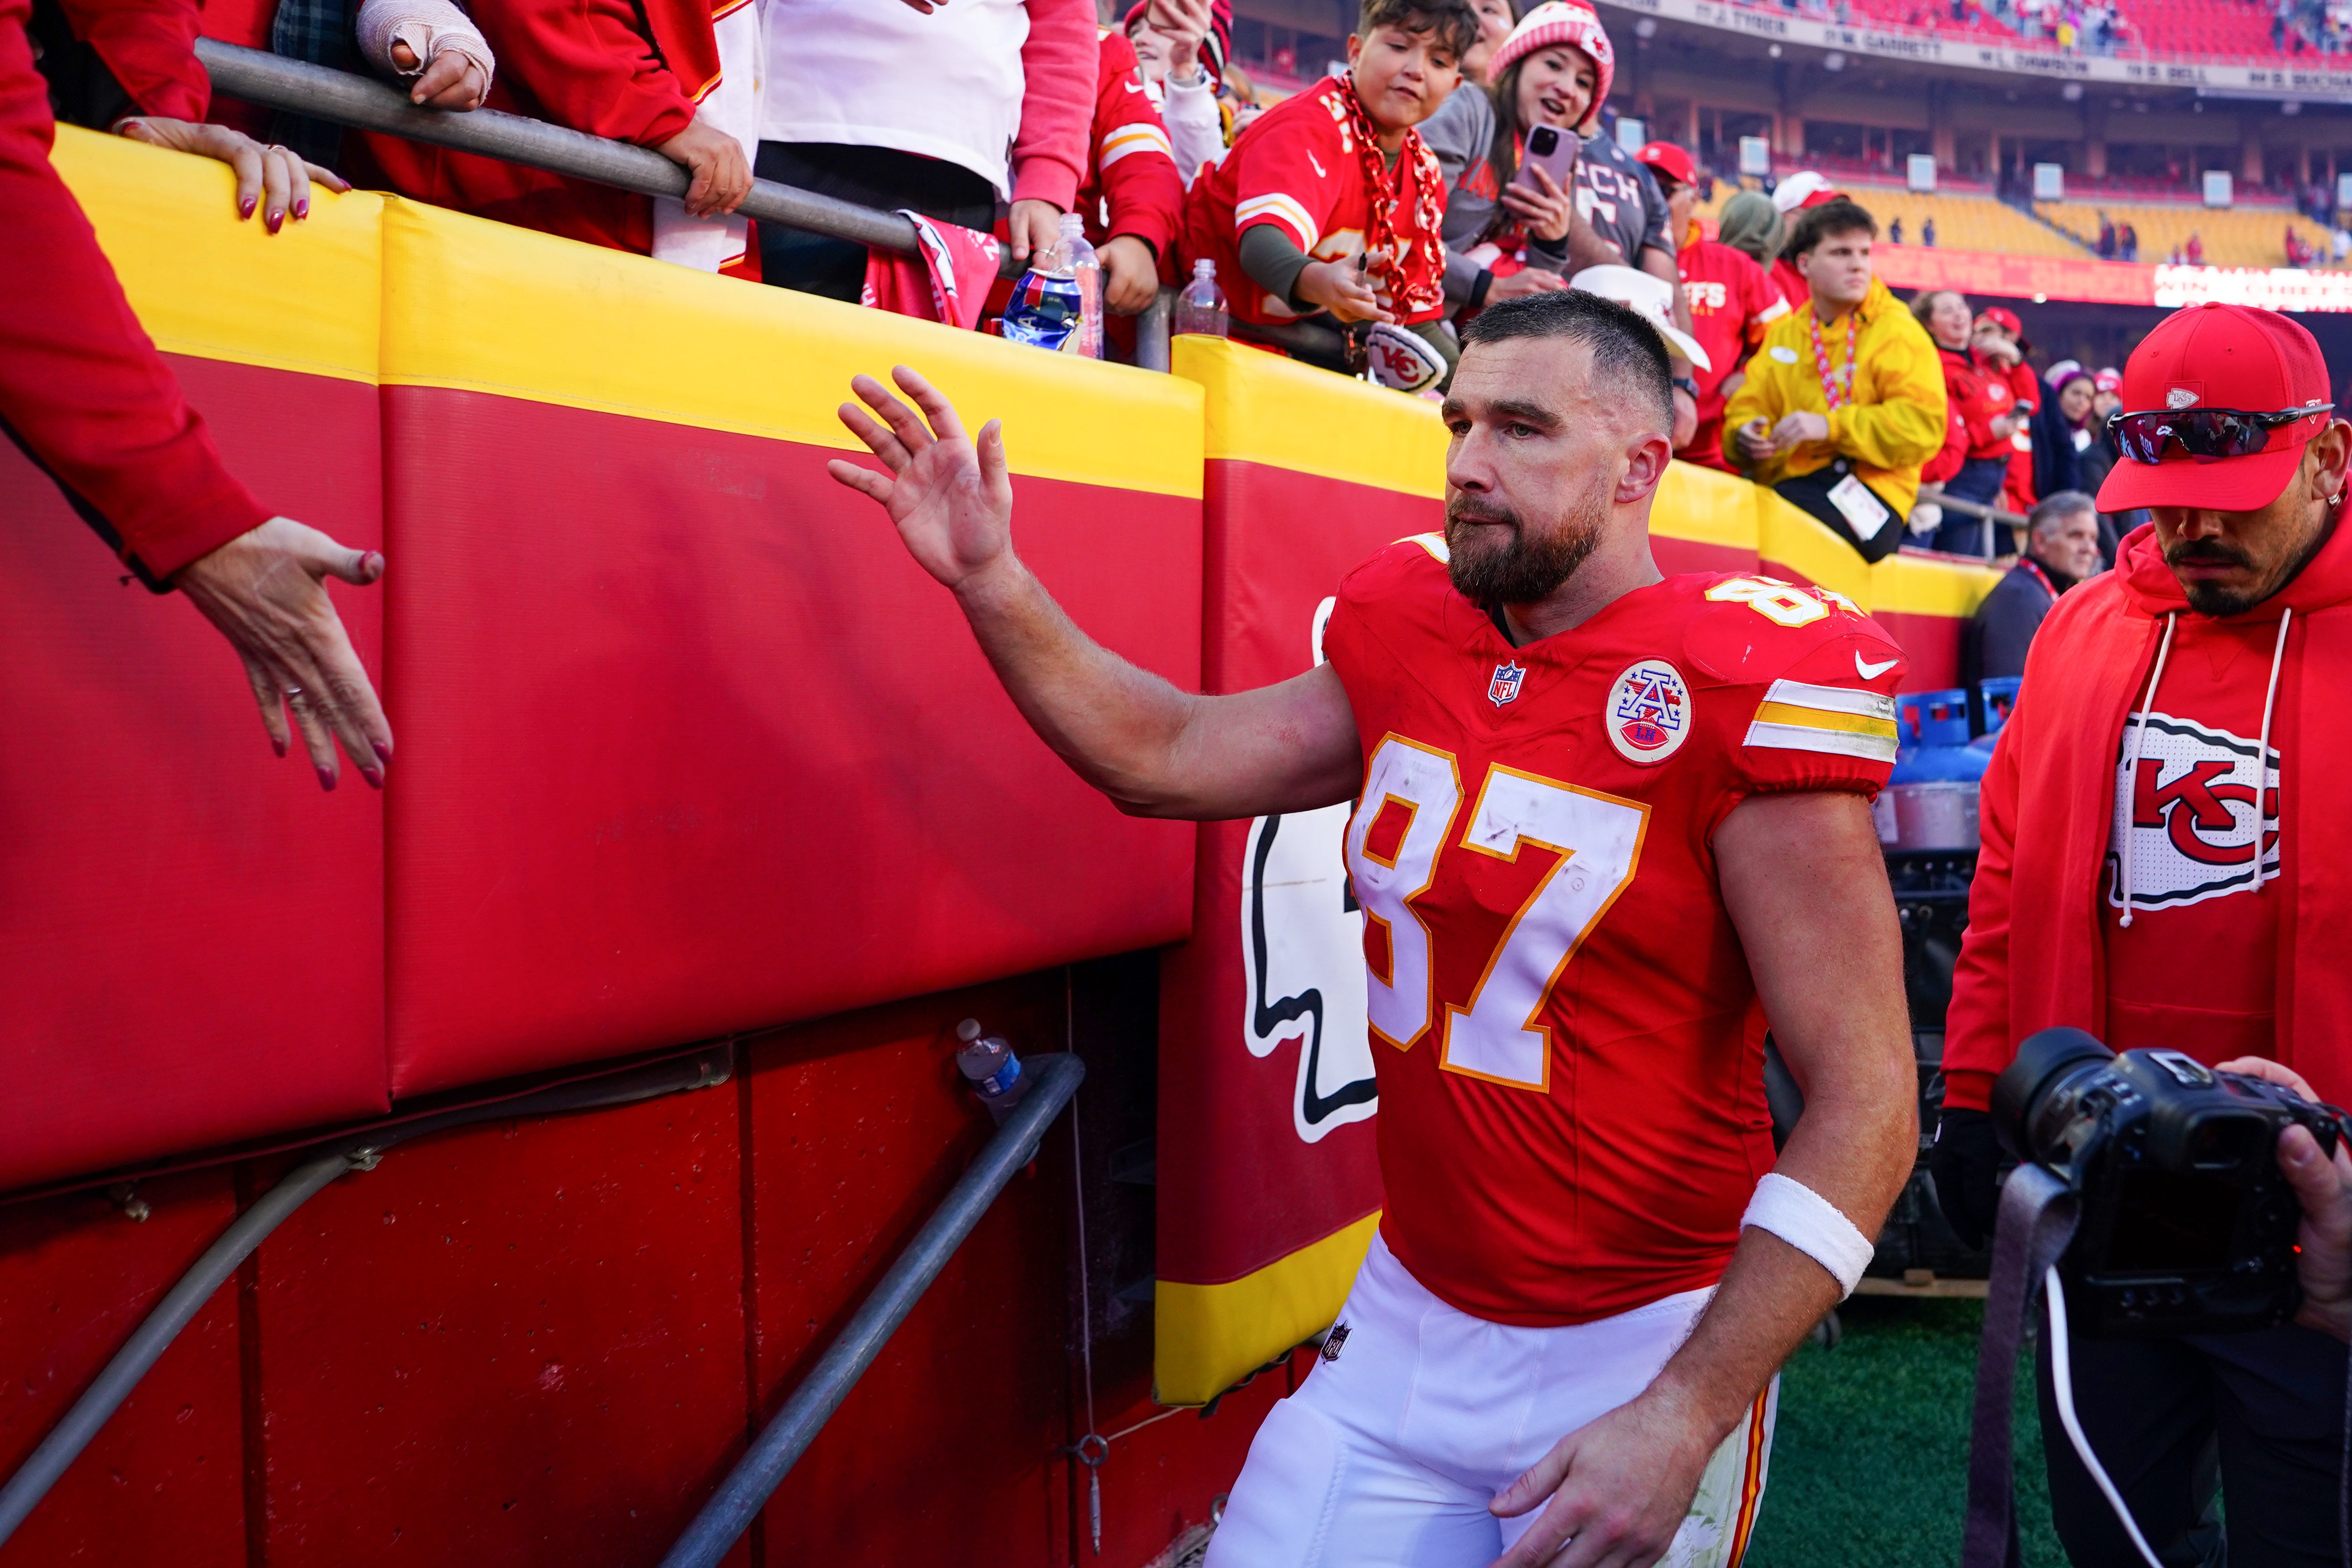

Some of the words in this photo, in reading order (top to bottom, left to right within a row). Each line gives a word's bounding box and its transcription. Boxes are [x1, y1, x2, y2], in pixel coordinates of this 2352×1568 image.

[1492, 681, 1513, 699] NFL
[1617, 668, 1681, 730] A
[1635, 726, 1656, 742] LH
[2126, 758, 2279, 866] KC
[1344, 730, 1652, 1094] 87
